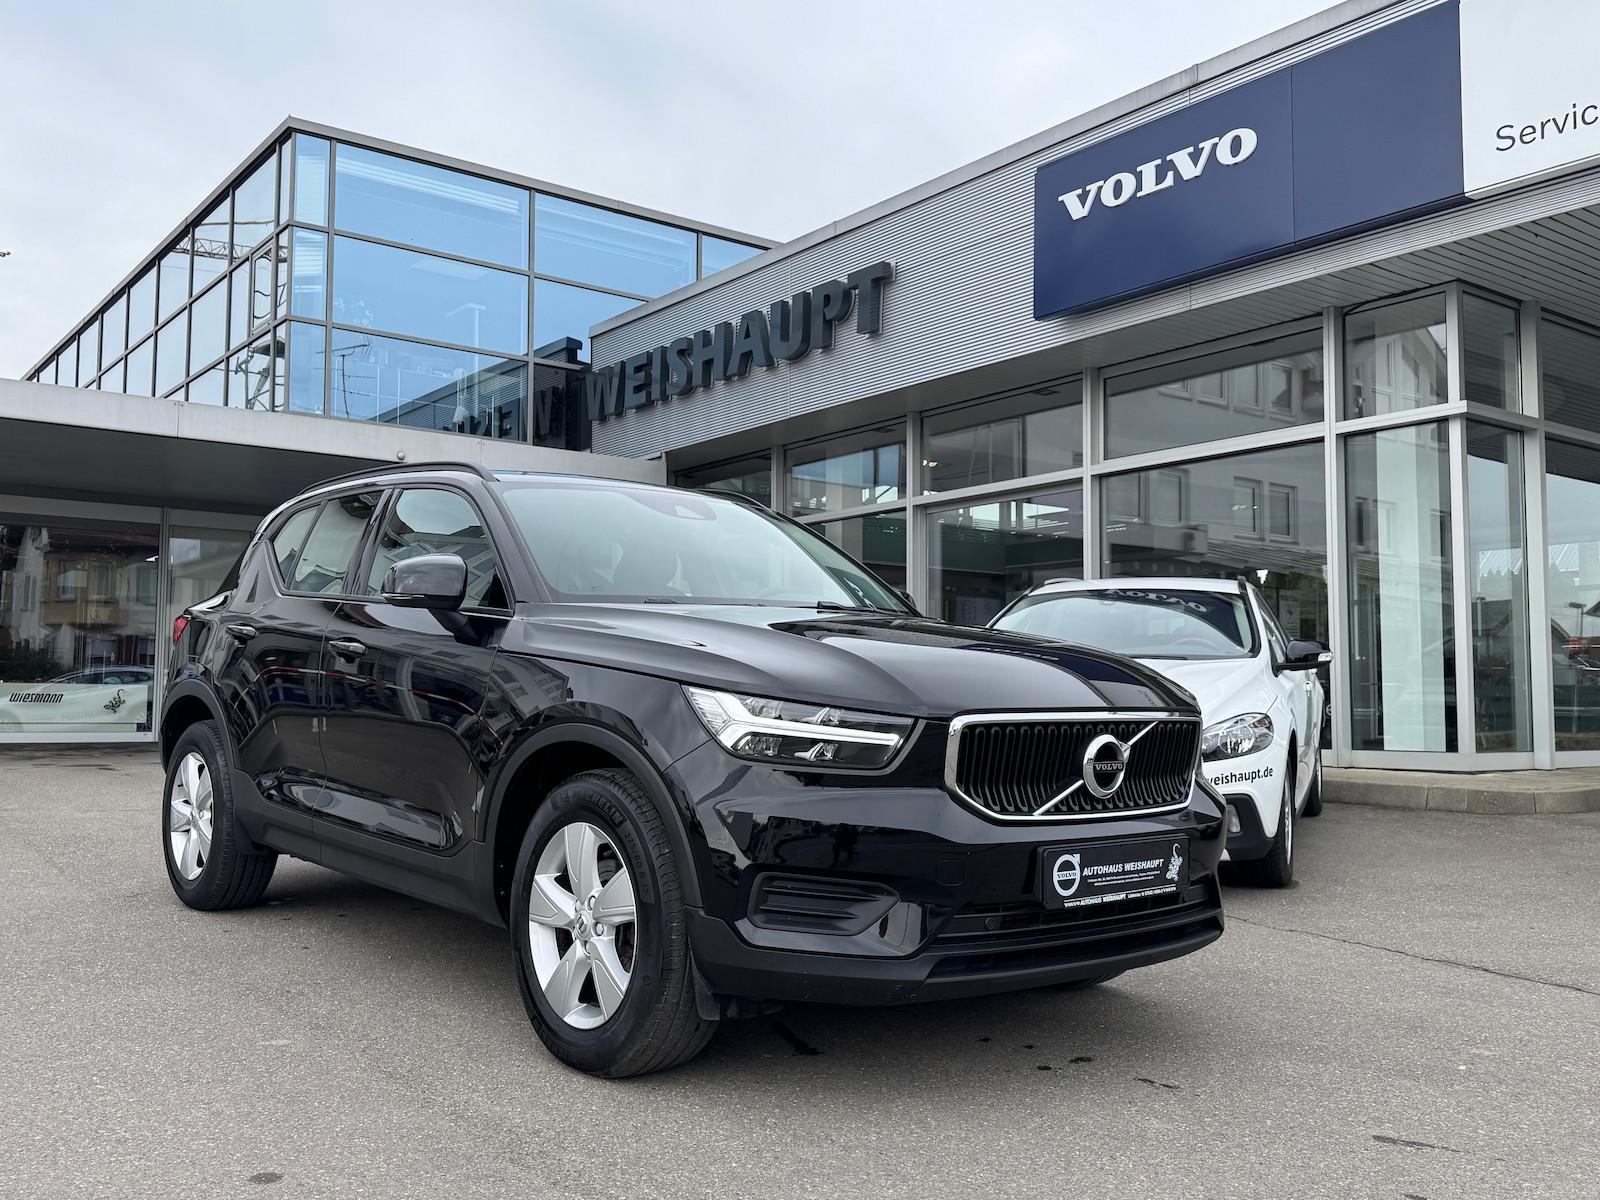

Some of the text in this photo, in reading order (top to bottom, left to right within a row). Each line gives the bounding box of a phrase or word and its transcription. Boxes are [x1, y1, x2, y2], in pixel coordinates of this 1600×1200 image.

[1496, 103, 1599, 151] Servic
[1057, 127, 1258, 221] VOLVO
[582, 261, 895, 422] WEISHAUPT
[1095, 763, 1123, 771] VOLVO
[1082, 863, 1123, 876] AUTOHAUS
[1124, 859, 1165, 871] WEISHAUPT
